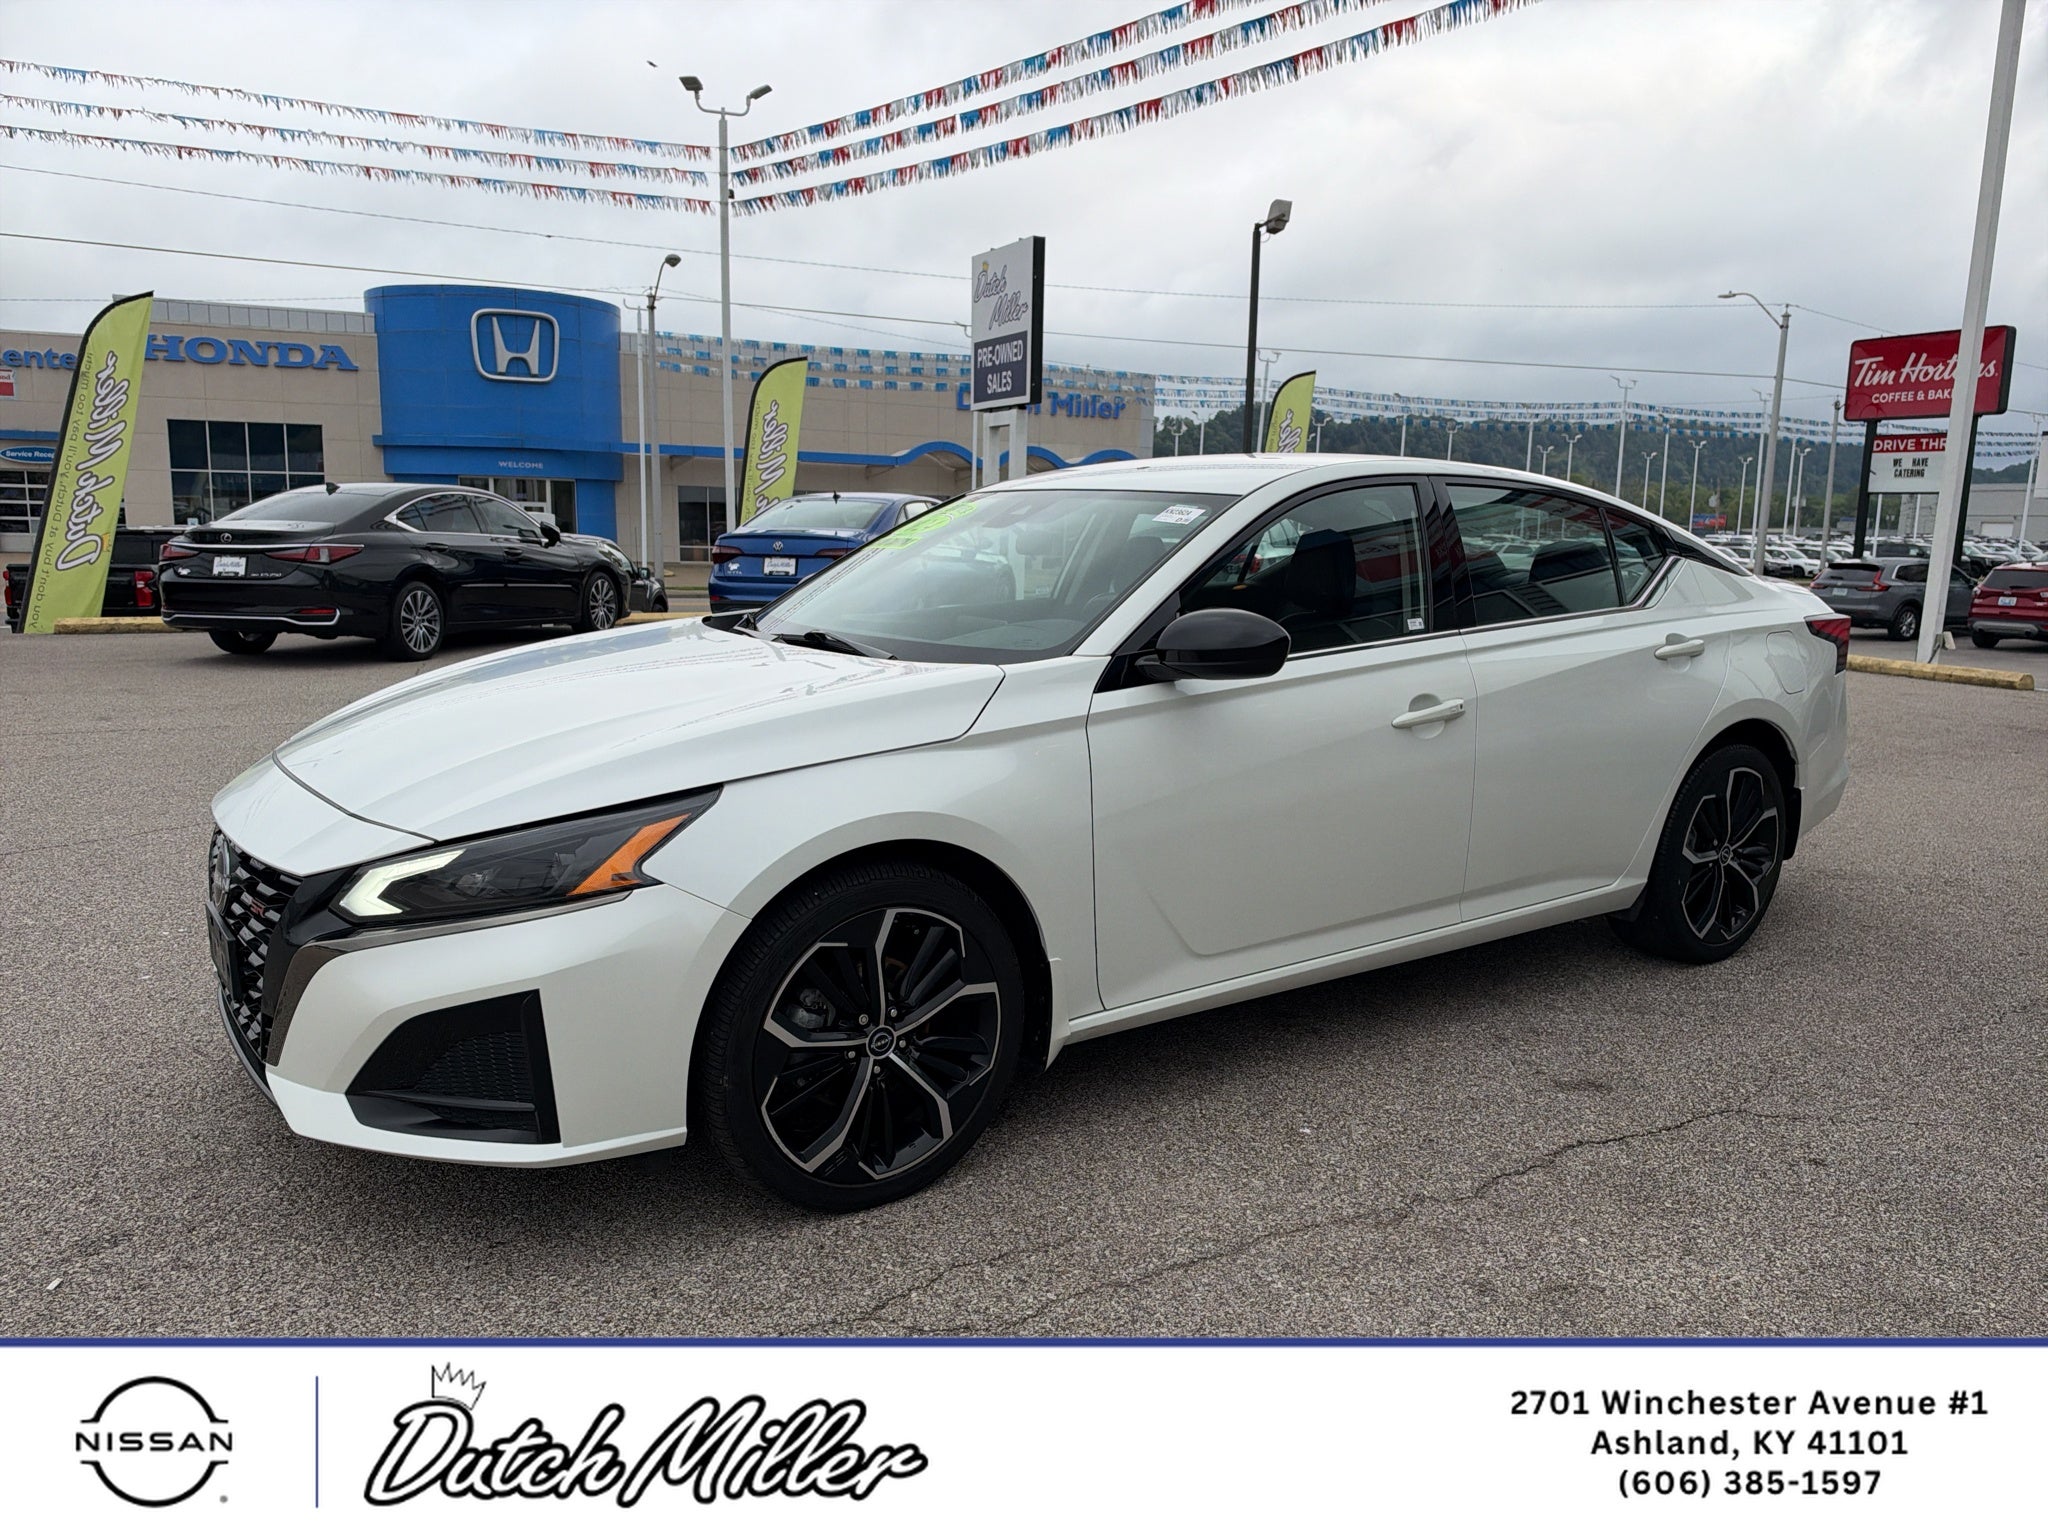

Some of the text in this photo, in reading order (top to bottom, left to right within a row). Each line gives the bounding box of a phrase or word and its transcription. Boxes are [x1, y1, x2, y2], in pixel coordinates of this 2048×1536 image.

[974, 264, 1008, 304] Dutch
[988, 291, 1028, 330] Miller
[0, 347, 79, 370] ente
[145, 334, 360, 371] HONDA
[977, 339, 1024, 369] PRE-OWNED
[1854, 352, 1996, 388] Tim Horts
[986, 370, 1012, 394] SALES
[1046, 391, 1126, 419] Miller
[1872, 388, 1954, 404] COFFEE & BAK
[6, 450, 32, 458] Service
[1873, 438, 1947, 452] DRIVE THR
[498, 461, 544, 470] WELCOME
[1893, 458, 1929, 468] WE HAVE
[1894, 468, 1926, 478] CATERING
